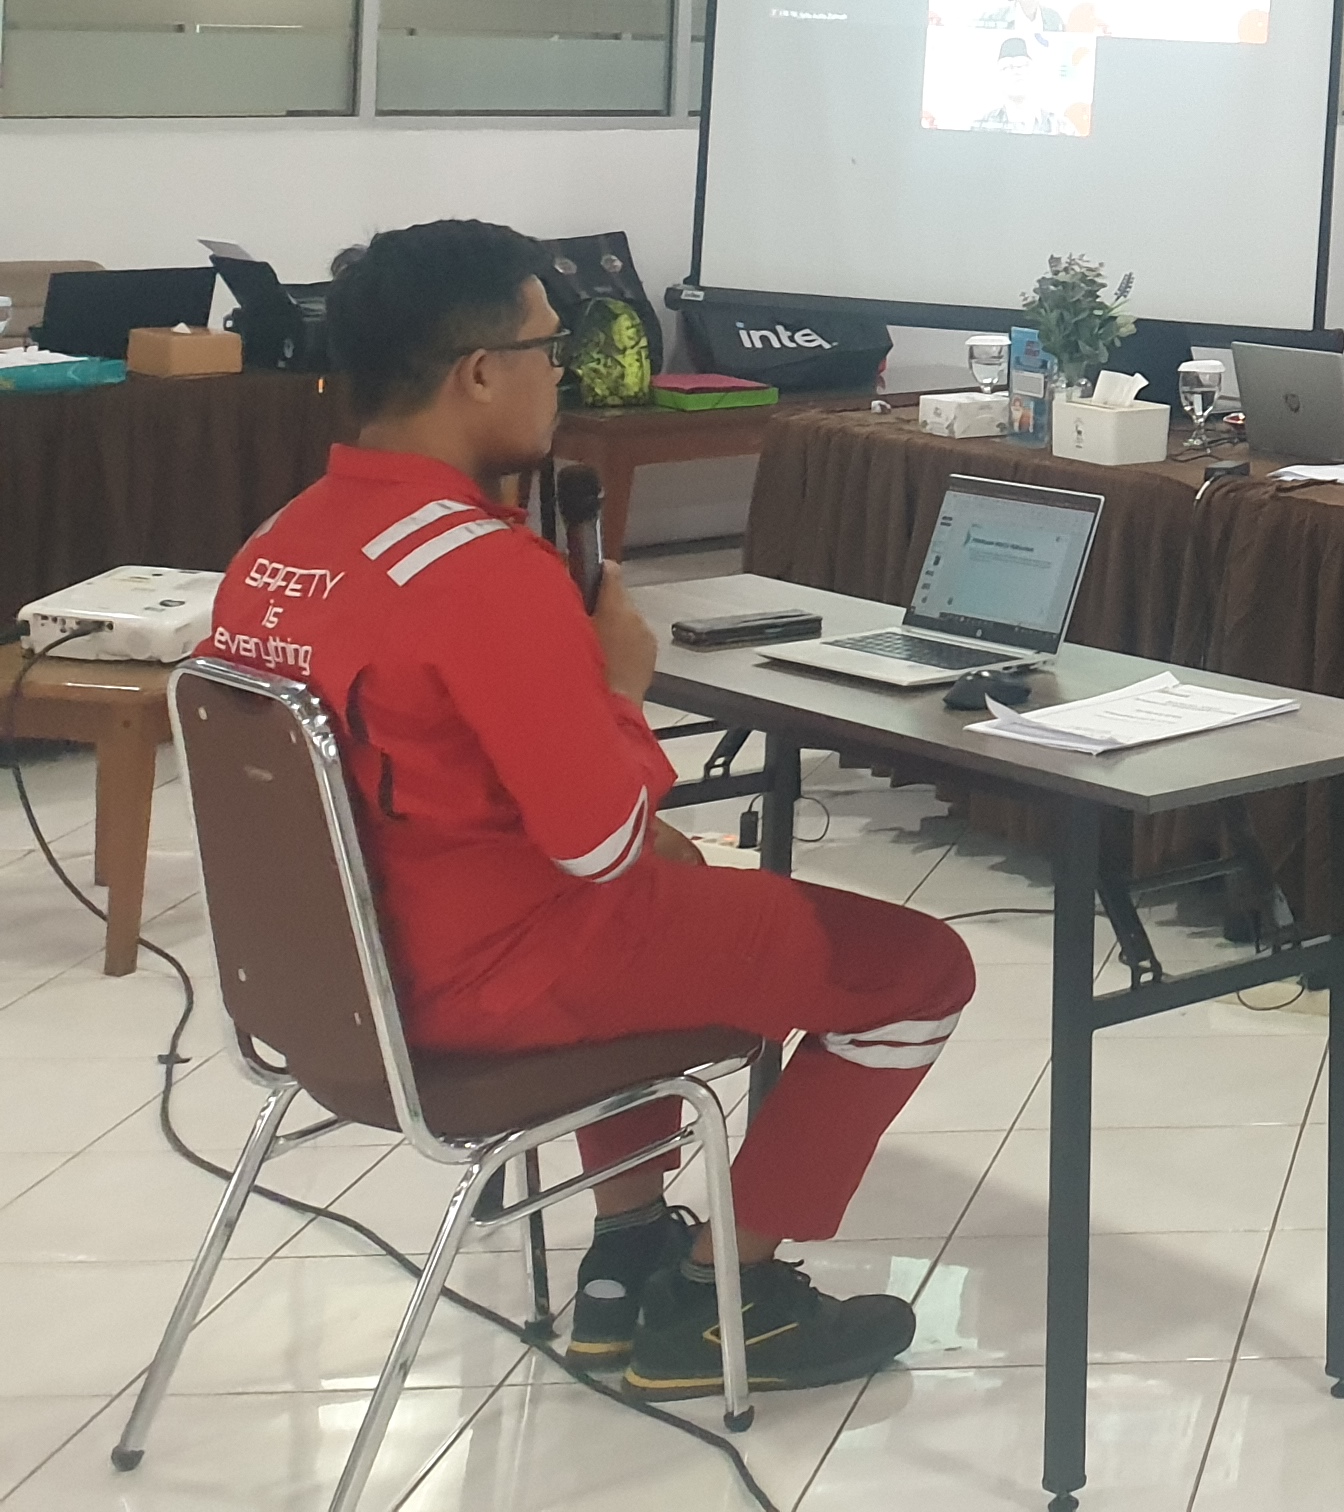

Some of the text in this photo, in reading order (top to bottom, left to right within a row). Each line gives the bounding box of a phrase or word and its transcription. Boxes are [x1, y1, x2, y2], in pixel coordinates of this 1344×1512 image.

[245, 558, 345, 599] SAFETY
[261, 599, 284, 629] is
[214, 626, 313, 676] everything
